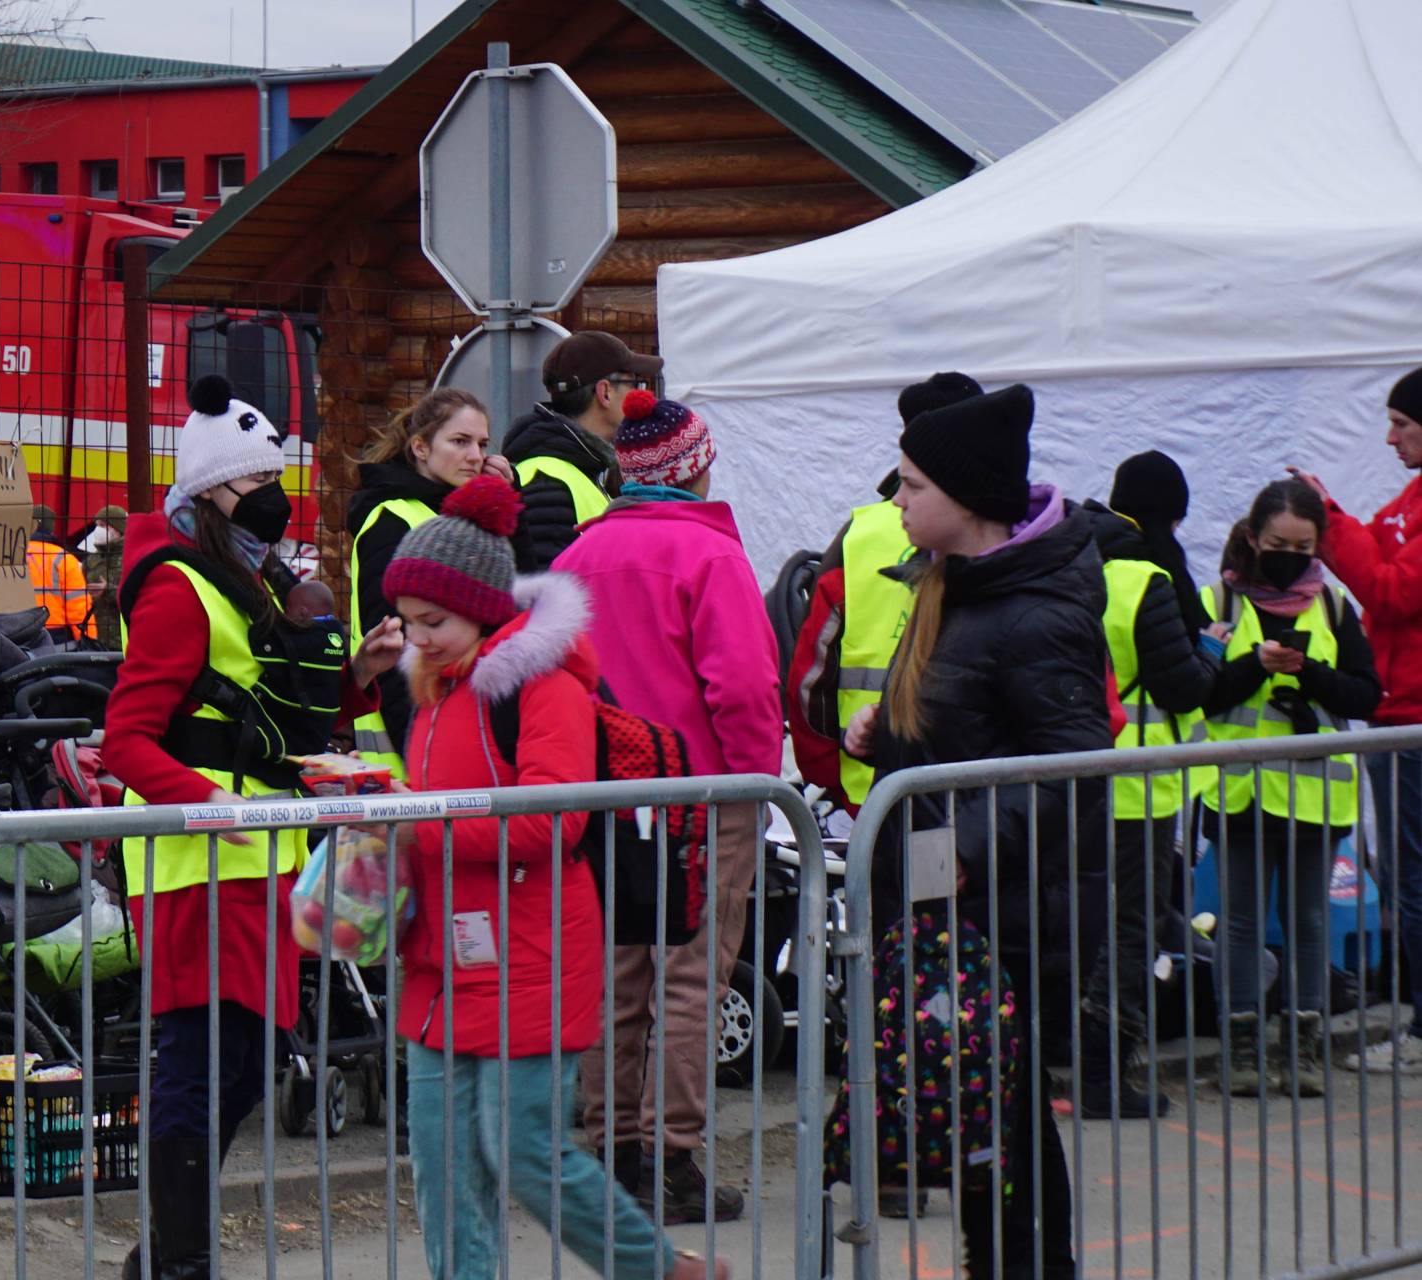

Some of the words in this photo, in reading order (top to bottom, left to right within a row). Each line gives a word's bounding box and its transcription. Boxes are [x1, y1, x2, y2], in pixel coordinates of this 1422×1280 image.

[241, 808, 267, 823] 0850
[271, 808, 290, 822] 850
[293, 807, 312, 821] 123
[370, 803, 442, 817] www.toitoi.sk
